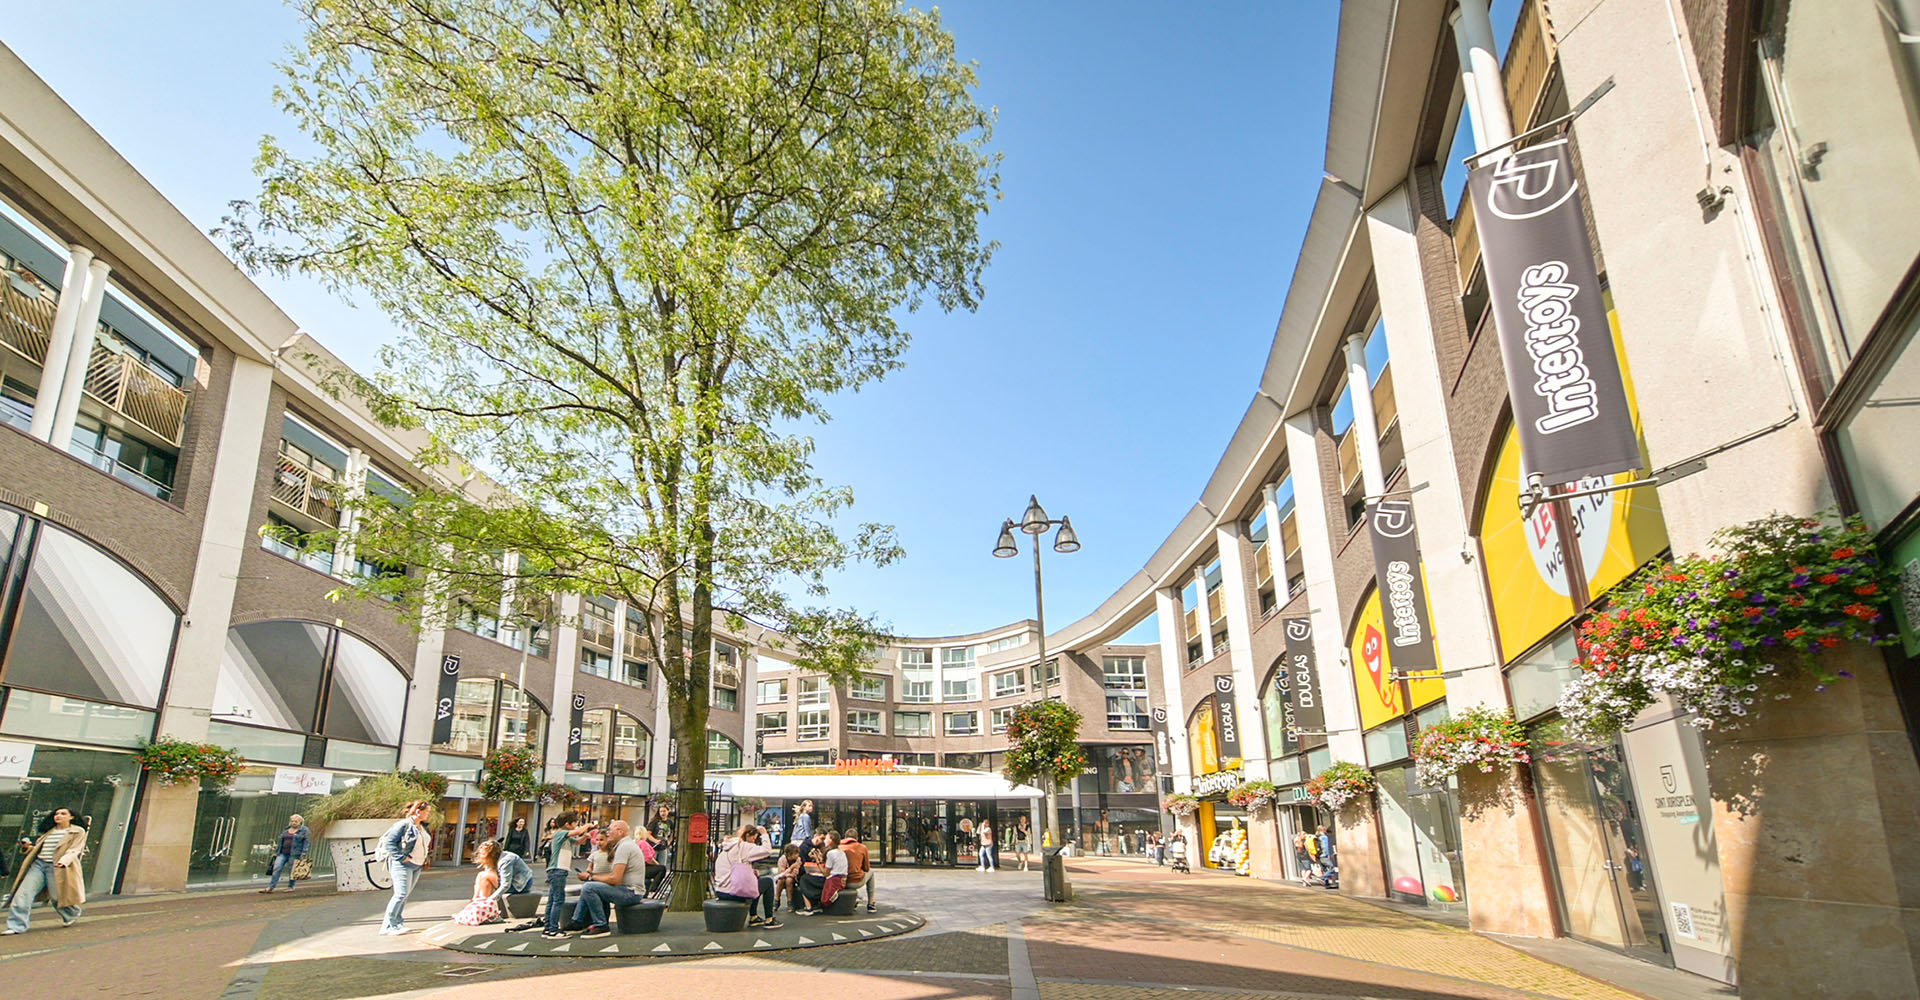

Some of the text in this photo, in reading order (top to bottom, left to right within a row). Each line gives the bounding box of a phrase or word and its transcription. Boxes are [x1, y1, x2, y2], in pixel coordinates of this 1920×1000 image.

[1518, 261, 1598, 434] Intertoys
[1387, 561, 1421, 646] Intertoys
[1295, 654, 1314, 708] DOUGLAS
[1220, 702, 1235, 742] DOUGLAS
[1198, 770, 1238, 795] Intertoys
[1293, 786, 1313, 801] DOUG
